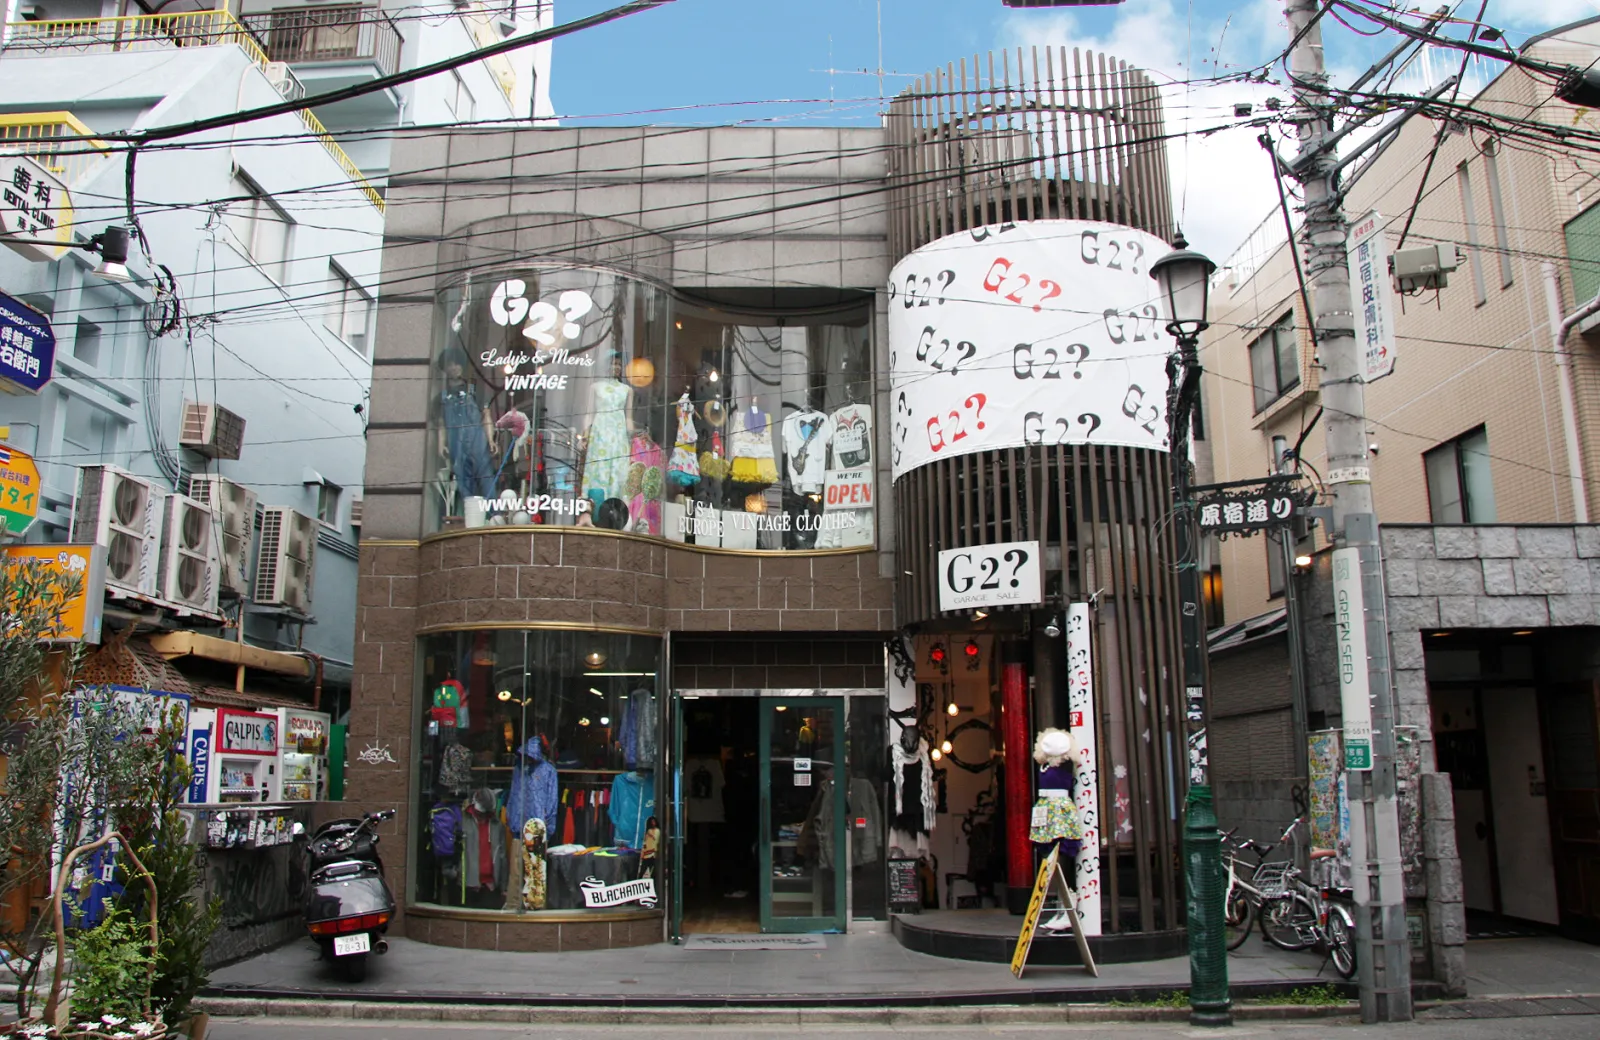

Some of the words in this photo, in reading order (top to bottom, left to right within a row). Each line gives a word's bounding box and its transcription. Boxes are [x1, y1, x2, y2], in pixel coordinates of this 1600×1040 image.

[13, 165, 51, 208] 歯科
[1081, 230, 1144, 275] G2?
[904, 269, 956, 309] G2?
[983, 257, 1062, 312] G2?
[490, 278, 593, 346] G2?
[1103, 304, 1159, 344] G2?
[480, 347, 530, 373] Lady's
[531, 350, 547, 364] &
[549, 347, 596, 367] Men's
[916, 325, 977, 376] G2?
[1013, 343, 1090, 379] G2?
[927, 393, 987, 453] G2?
[478, 493, 588, 516] www.g2q.jp
[827, 483, 872, 505] OPEN
[1200, 497, 1292, 526] 原宿通り
[678, 516, 724, 537] EUROPE
[732, 511, 791, 532] VINTAGE
[796, 511, 856, 532] CLOTHES
[947, 549, 1029, 594] G2?
[953, 593, 989, 604] GARAGE
[996, 591, 1021, 600] SALE
[1339, 589, 1351, 642] GREEN
[1342, 644, 1354, 685] SEED
[225, 720, 261, 749] CALPIS
[193, 736, 208, 786] CALPIS
[591, 882, 651, 904] BLACKANNY
